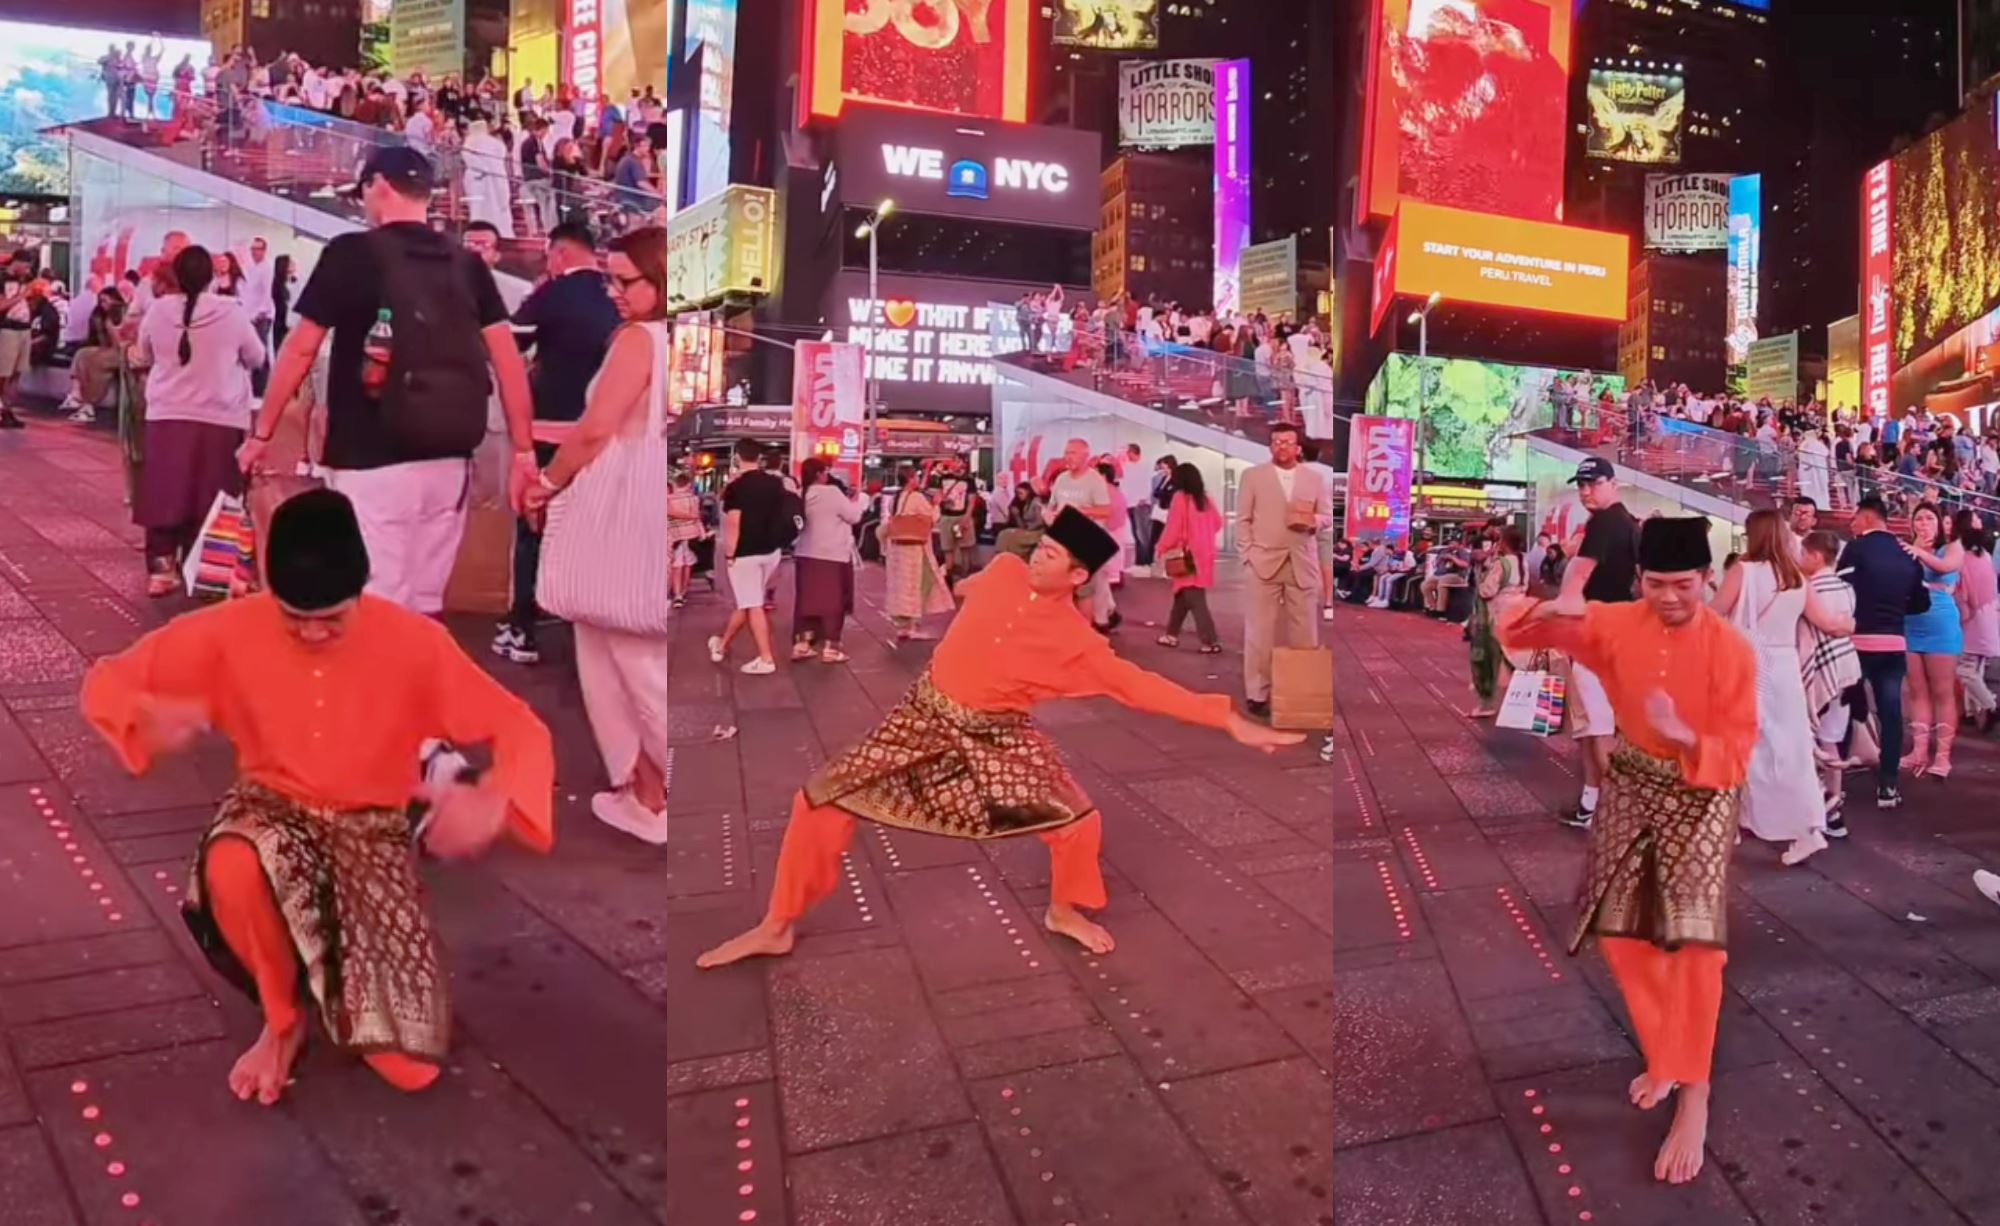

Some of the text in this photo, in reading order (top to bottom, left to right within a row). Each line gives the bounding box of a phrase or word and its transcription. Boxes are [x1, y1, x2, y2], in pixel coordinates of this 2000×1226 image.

[1130, 63, 1180, 89] LITTLE
[1606, 80, 1666, 100] Harry Potter
[1130, 92, 1216, 132] HORRORS
[881, 144, 1068, 192] WE NYC
[1655, 176, 1700, 198] LITTLE
[741, 193, 765, 280] HELLO!
[1654, 202, 1729, 238] HORRORS
[1423, 241, 1607, 277] START YOUR ADVENTURE IN PERU
[848, 298, 886, 324] WE
[915, 302, 969, 328] THAT
[973, 307, 993, 331] IF
[913, 330, 935, 355] IT
[939, 332, 993, 358] HERE
[912, 358, 934, 382] IT
[1870, 343, 1888, 385] FREE
[743, 417, 777, 429] Family
